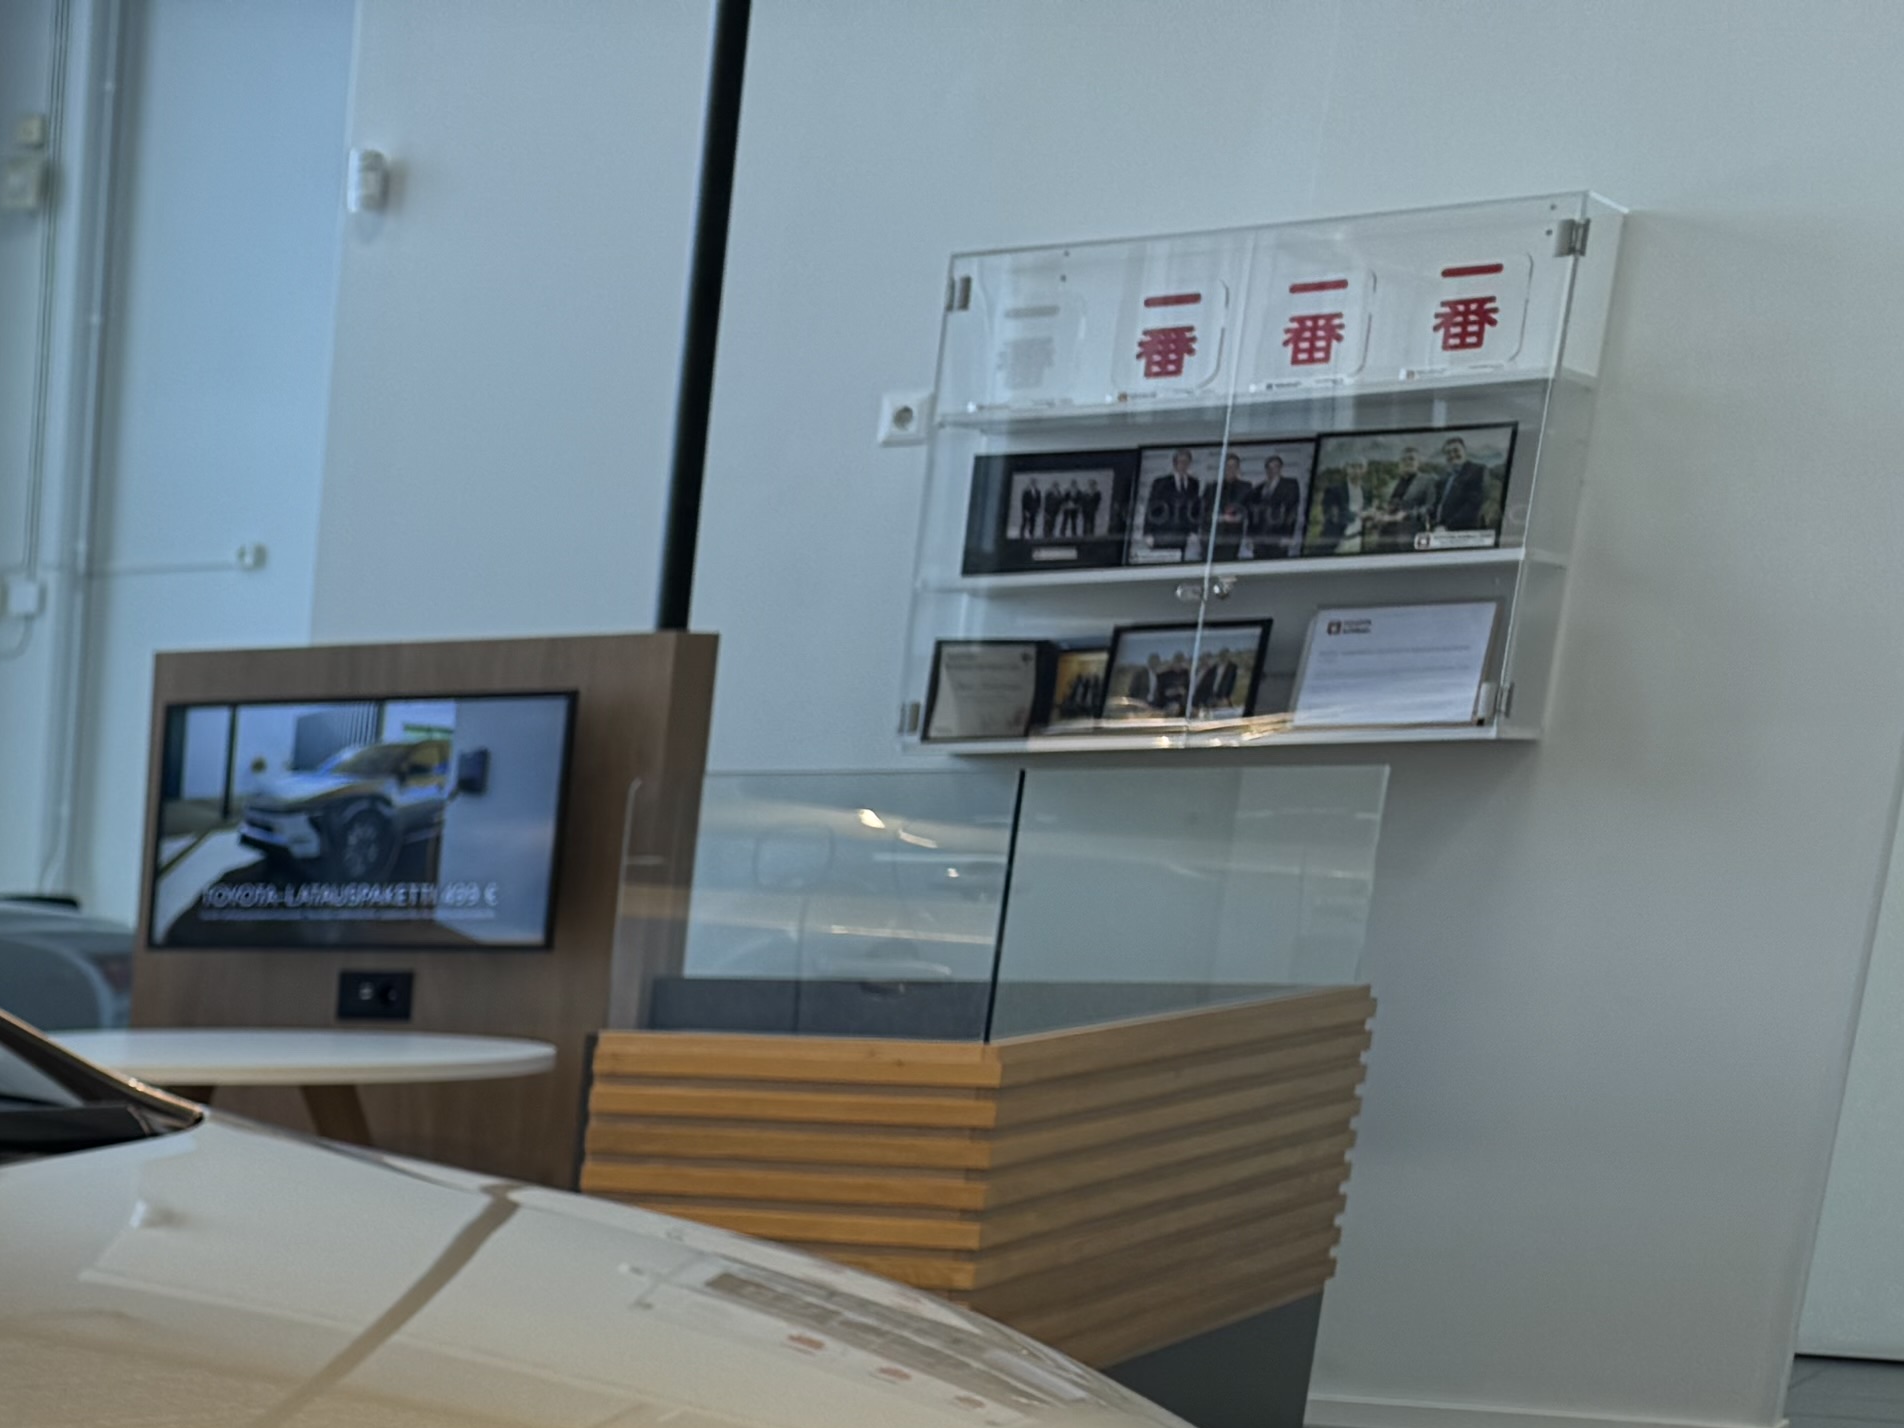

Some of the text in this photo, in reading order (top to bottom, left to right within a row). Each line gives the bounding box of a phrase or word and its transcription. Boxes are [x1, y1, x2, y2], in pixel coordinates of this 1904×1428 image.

[1283, 279, 1349, 366] 一番
[1433, 263, 1504, 352] 一番
[484, 881, 498, 907] €
